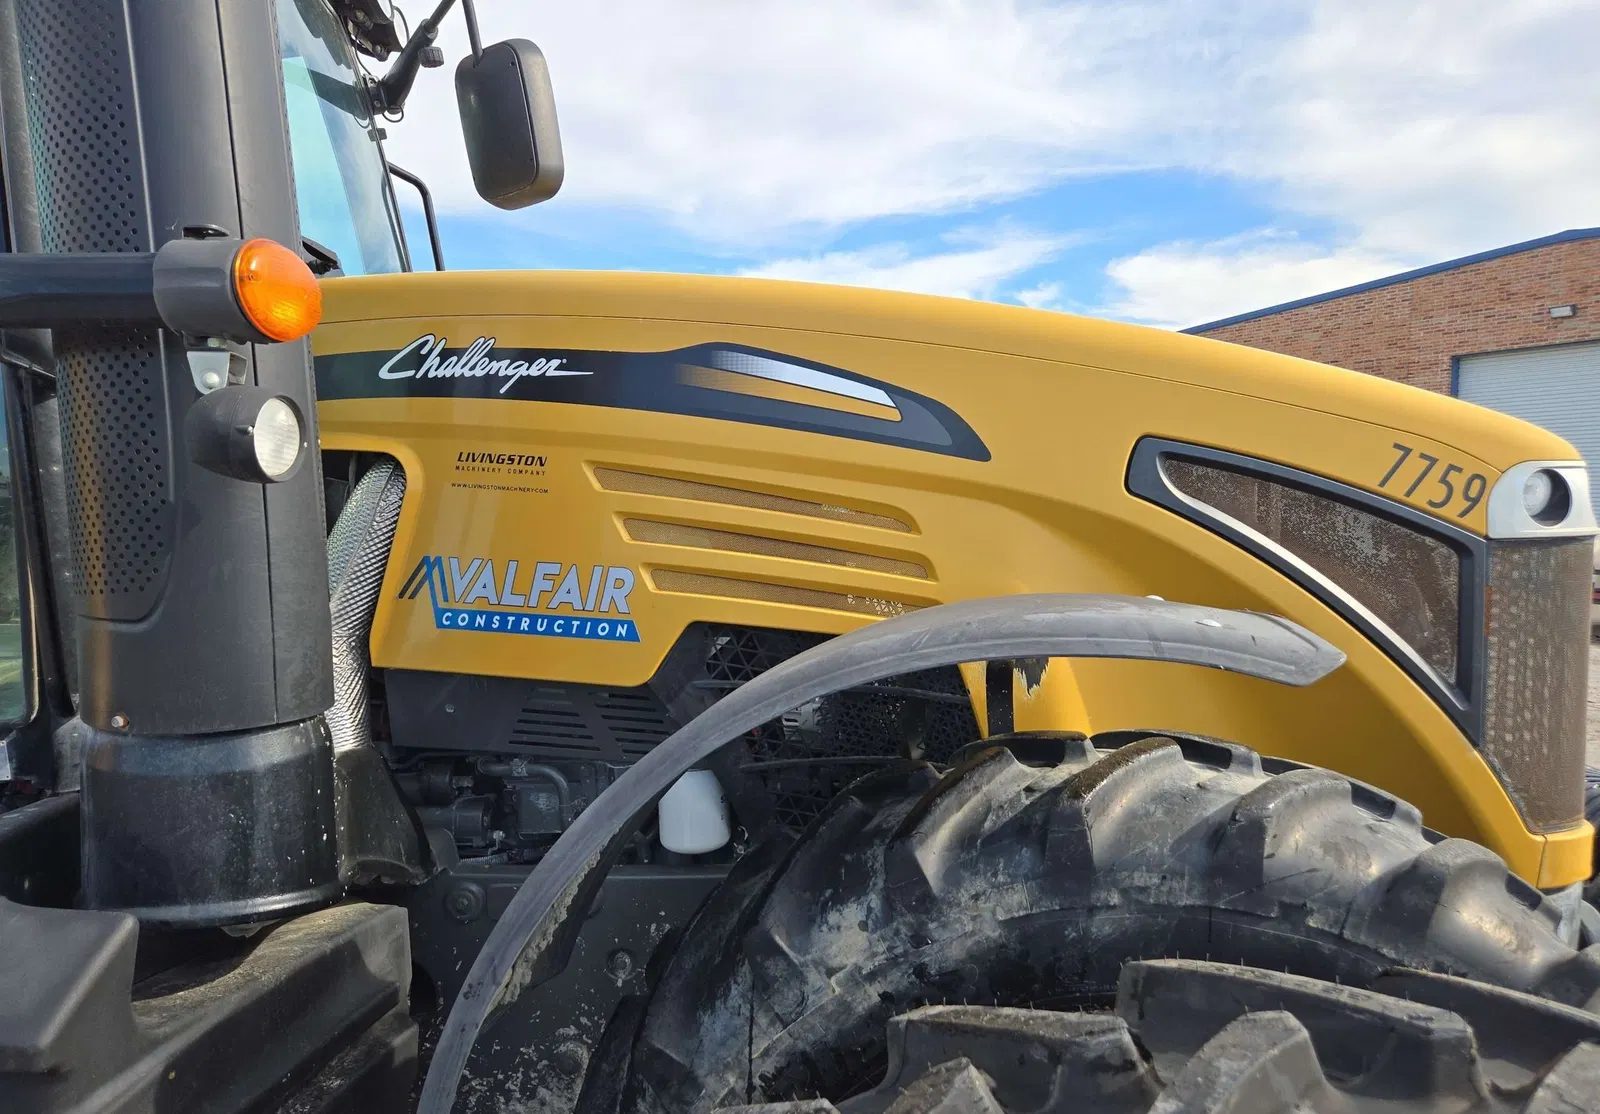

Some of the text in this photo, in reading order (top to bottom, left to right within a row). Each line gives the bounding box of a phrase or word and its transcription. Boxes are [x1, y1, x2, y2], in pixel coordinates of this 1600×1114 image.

[455, 465, 546, 476] MACHINERY COMPANY
[457, 451, 548, 466] LIVINGSTON
[1377, 442, 1487, 518] 7759
[449, 557, 635, 614] VALFAIR
[442, 612, 628, 638] CONSTRUCTION
